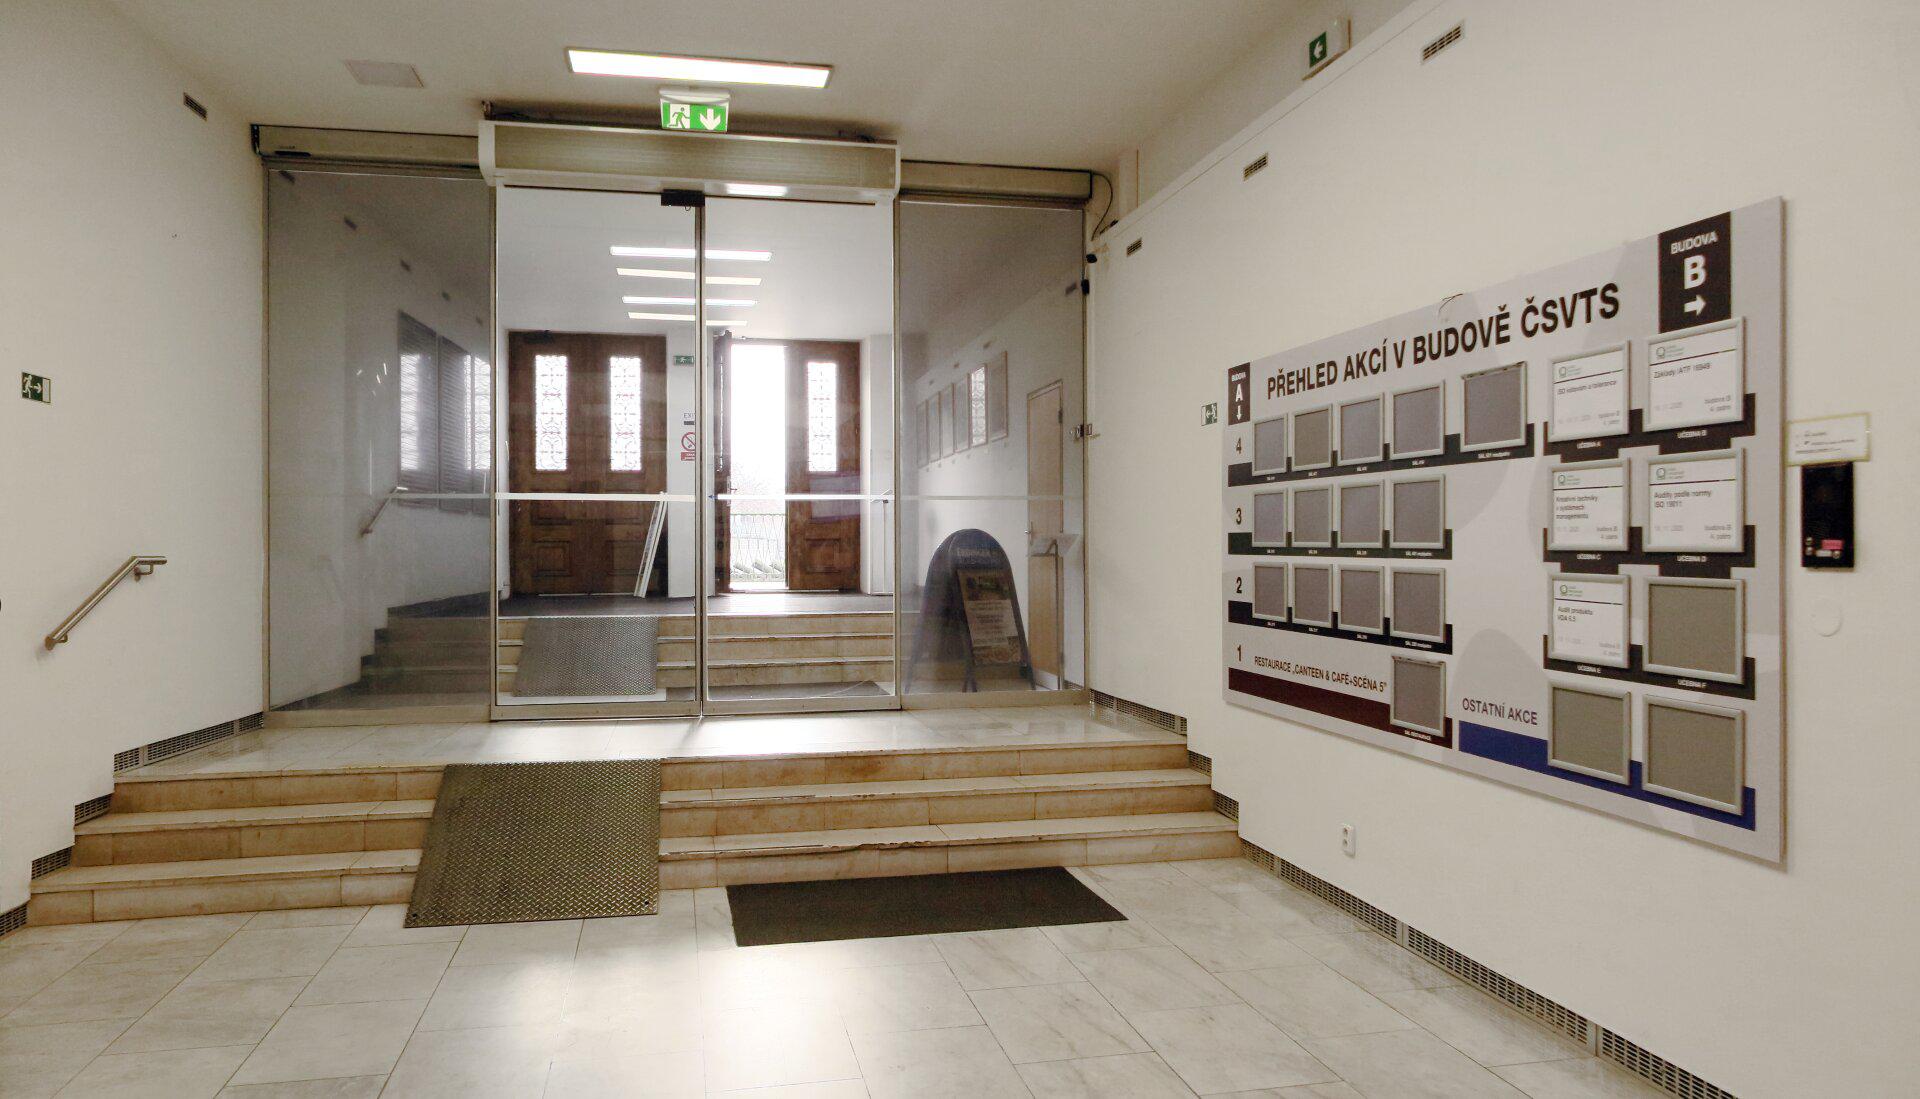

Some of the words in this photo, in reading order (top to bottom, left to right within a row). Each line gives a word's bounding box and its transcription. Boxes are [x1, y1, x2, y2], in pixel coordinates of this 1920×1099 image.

[1671, 231, 1717, 254] BUDOVA
[1683, 255, 1707, 290] B
[1267, 360, 1338, 400] PŘEHLED
[1343, 337, 1388, 382] AKCÍ
[1393, 340, 1407, 369] V
[1413, 304, 1511, 365] BUDOVĚ
[1520, 282, 1620, 338] ČSVTS
[1235, 384, 1244, 402] A
[1235, 437, 1242, 455] 4
[1235, 508, 1242, 525] 3
[1235, 577, 1242, 594] 2
[1237, 644, 1242, 662] 1
[1254, 655, 1291, 673] RESTAURACE
[1462, 697, 1505, 719] OSTATNÍ
[1508, 707, 1538, 726] AKCE
